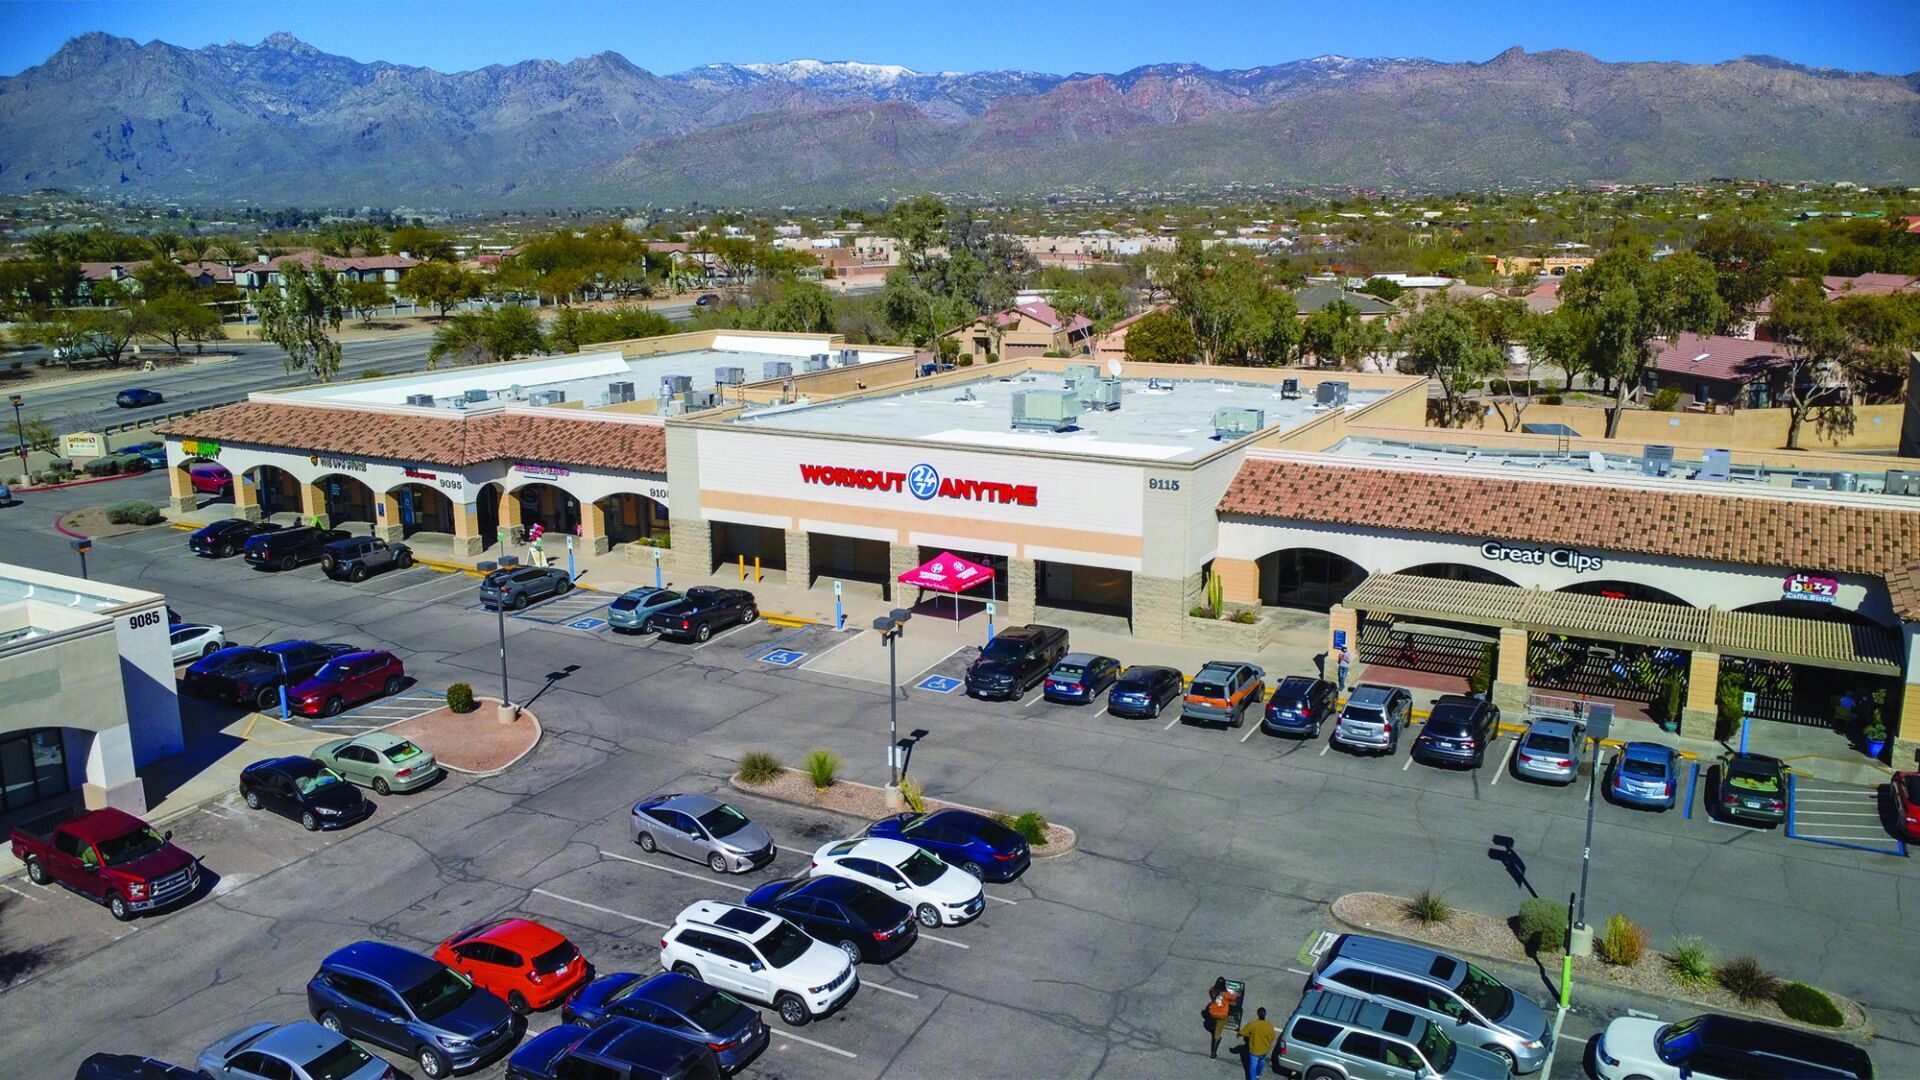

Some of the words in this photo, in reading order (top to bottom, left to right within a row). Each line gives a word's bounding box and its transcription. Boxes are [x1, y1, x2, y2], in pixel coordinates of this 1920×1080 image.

[182, 440, 221, 457] SUBWAY
[440, 479, 462, 489] 9095
[800, 464, 907, 493] WORKOUT
[1149, 478, 1180, 491] 9115
[938, 478, 1038, 507] ANYTIME
[1481, 541, 1544, 564] Great
[1549, 548, 1603, 573] Clips
[1790, 580, 1833, 595] buzz
[130, 611, 160, 629] 9085
